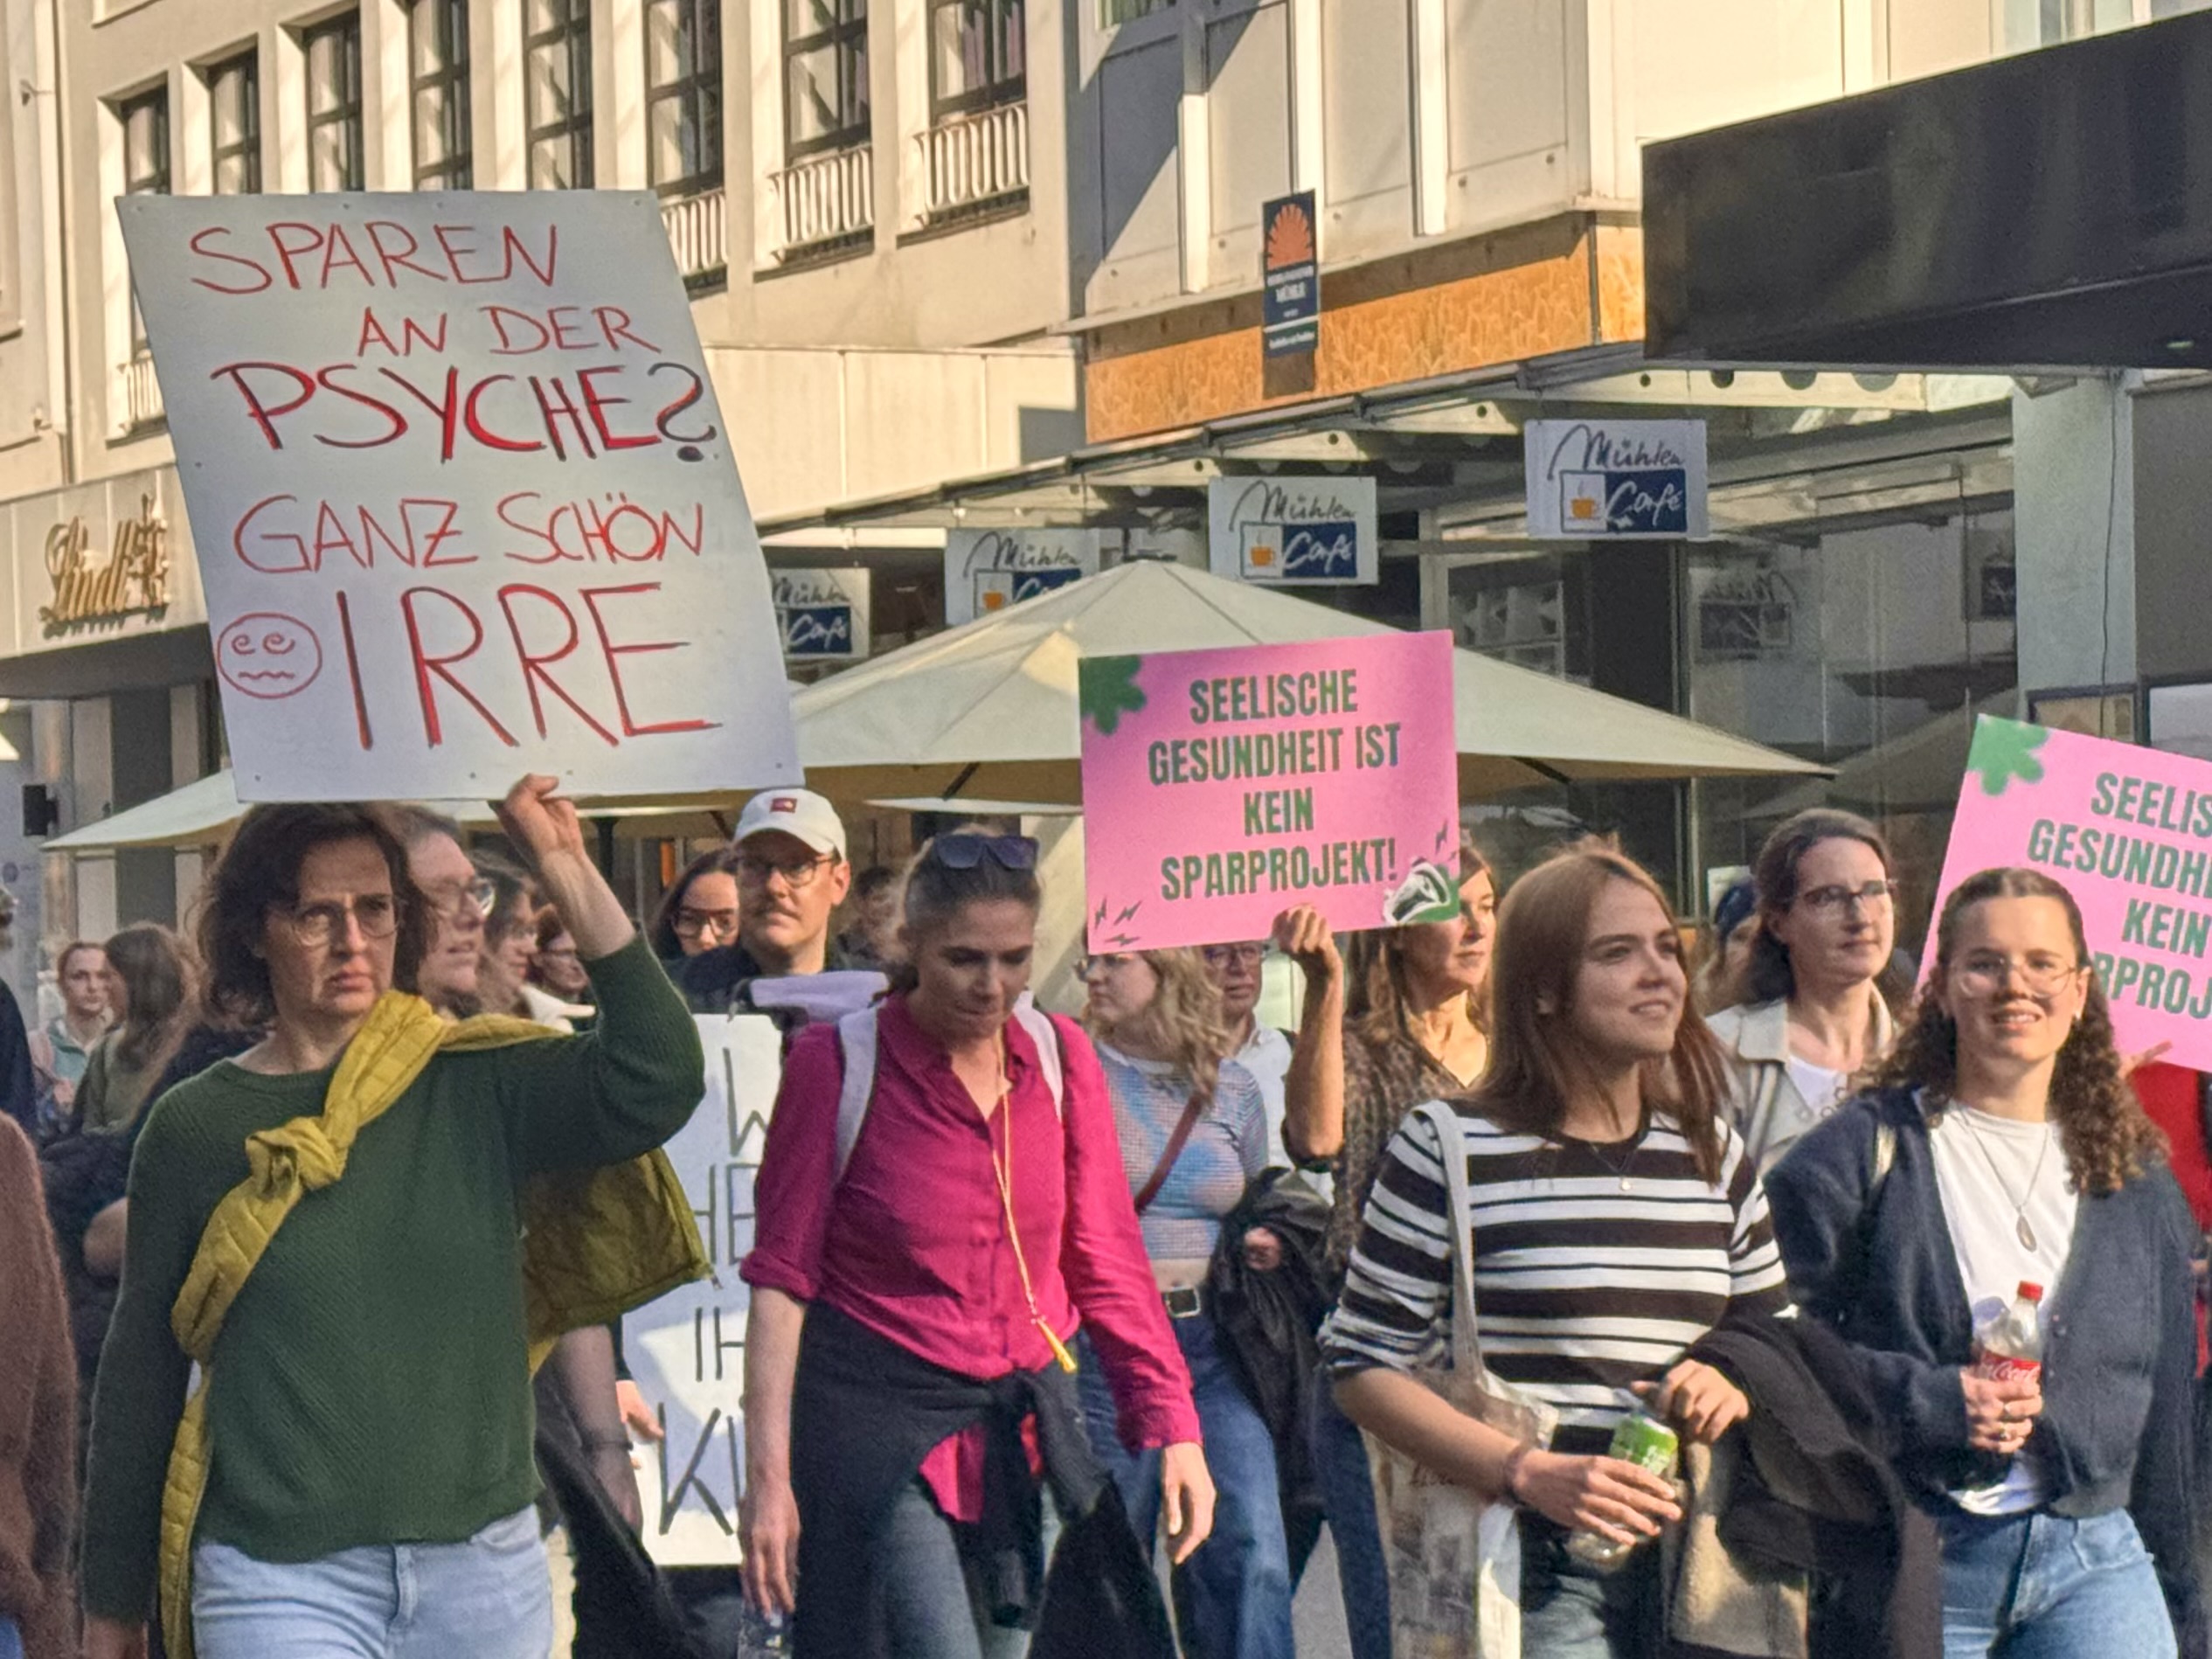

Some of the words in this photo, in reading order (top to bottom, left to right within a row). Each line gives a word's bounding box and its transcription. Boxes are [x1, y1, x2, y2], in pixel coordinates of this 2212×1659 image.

[191, 221, 557, 294] SPAREN
[358, 307, 447, 357] AN
[478, 306, 662, 354] DER
[211, 362, 717, 462] PSYCHE?
[1547, 424, 1685, 480] Mühlen
[233, 494, 478, 573] GANZ
[497, 491, 702, 565] SCHÖN
[1229, 480, 1356, 531] Mühlen
[336, 583, 724, 751] IRRE
[1189, 670, 1357, 724] SEELISCHE
[1148, 728, 1343, 786] GESUNDHEIT
[1356, 723, 1400, 768] IST
[1244, 788, 1314, 836] KEIN
[1161, 838, 1397, 901] SPARPROJEKT!
[2121, 899, 2212, 958] KEIN
[2093, 951, 2212, 1019] RPROJ
